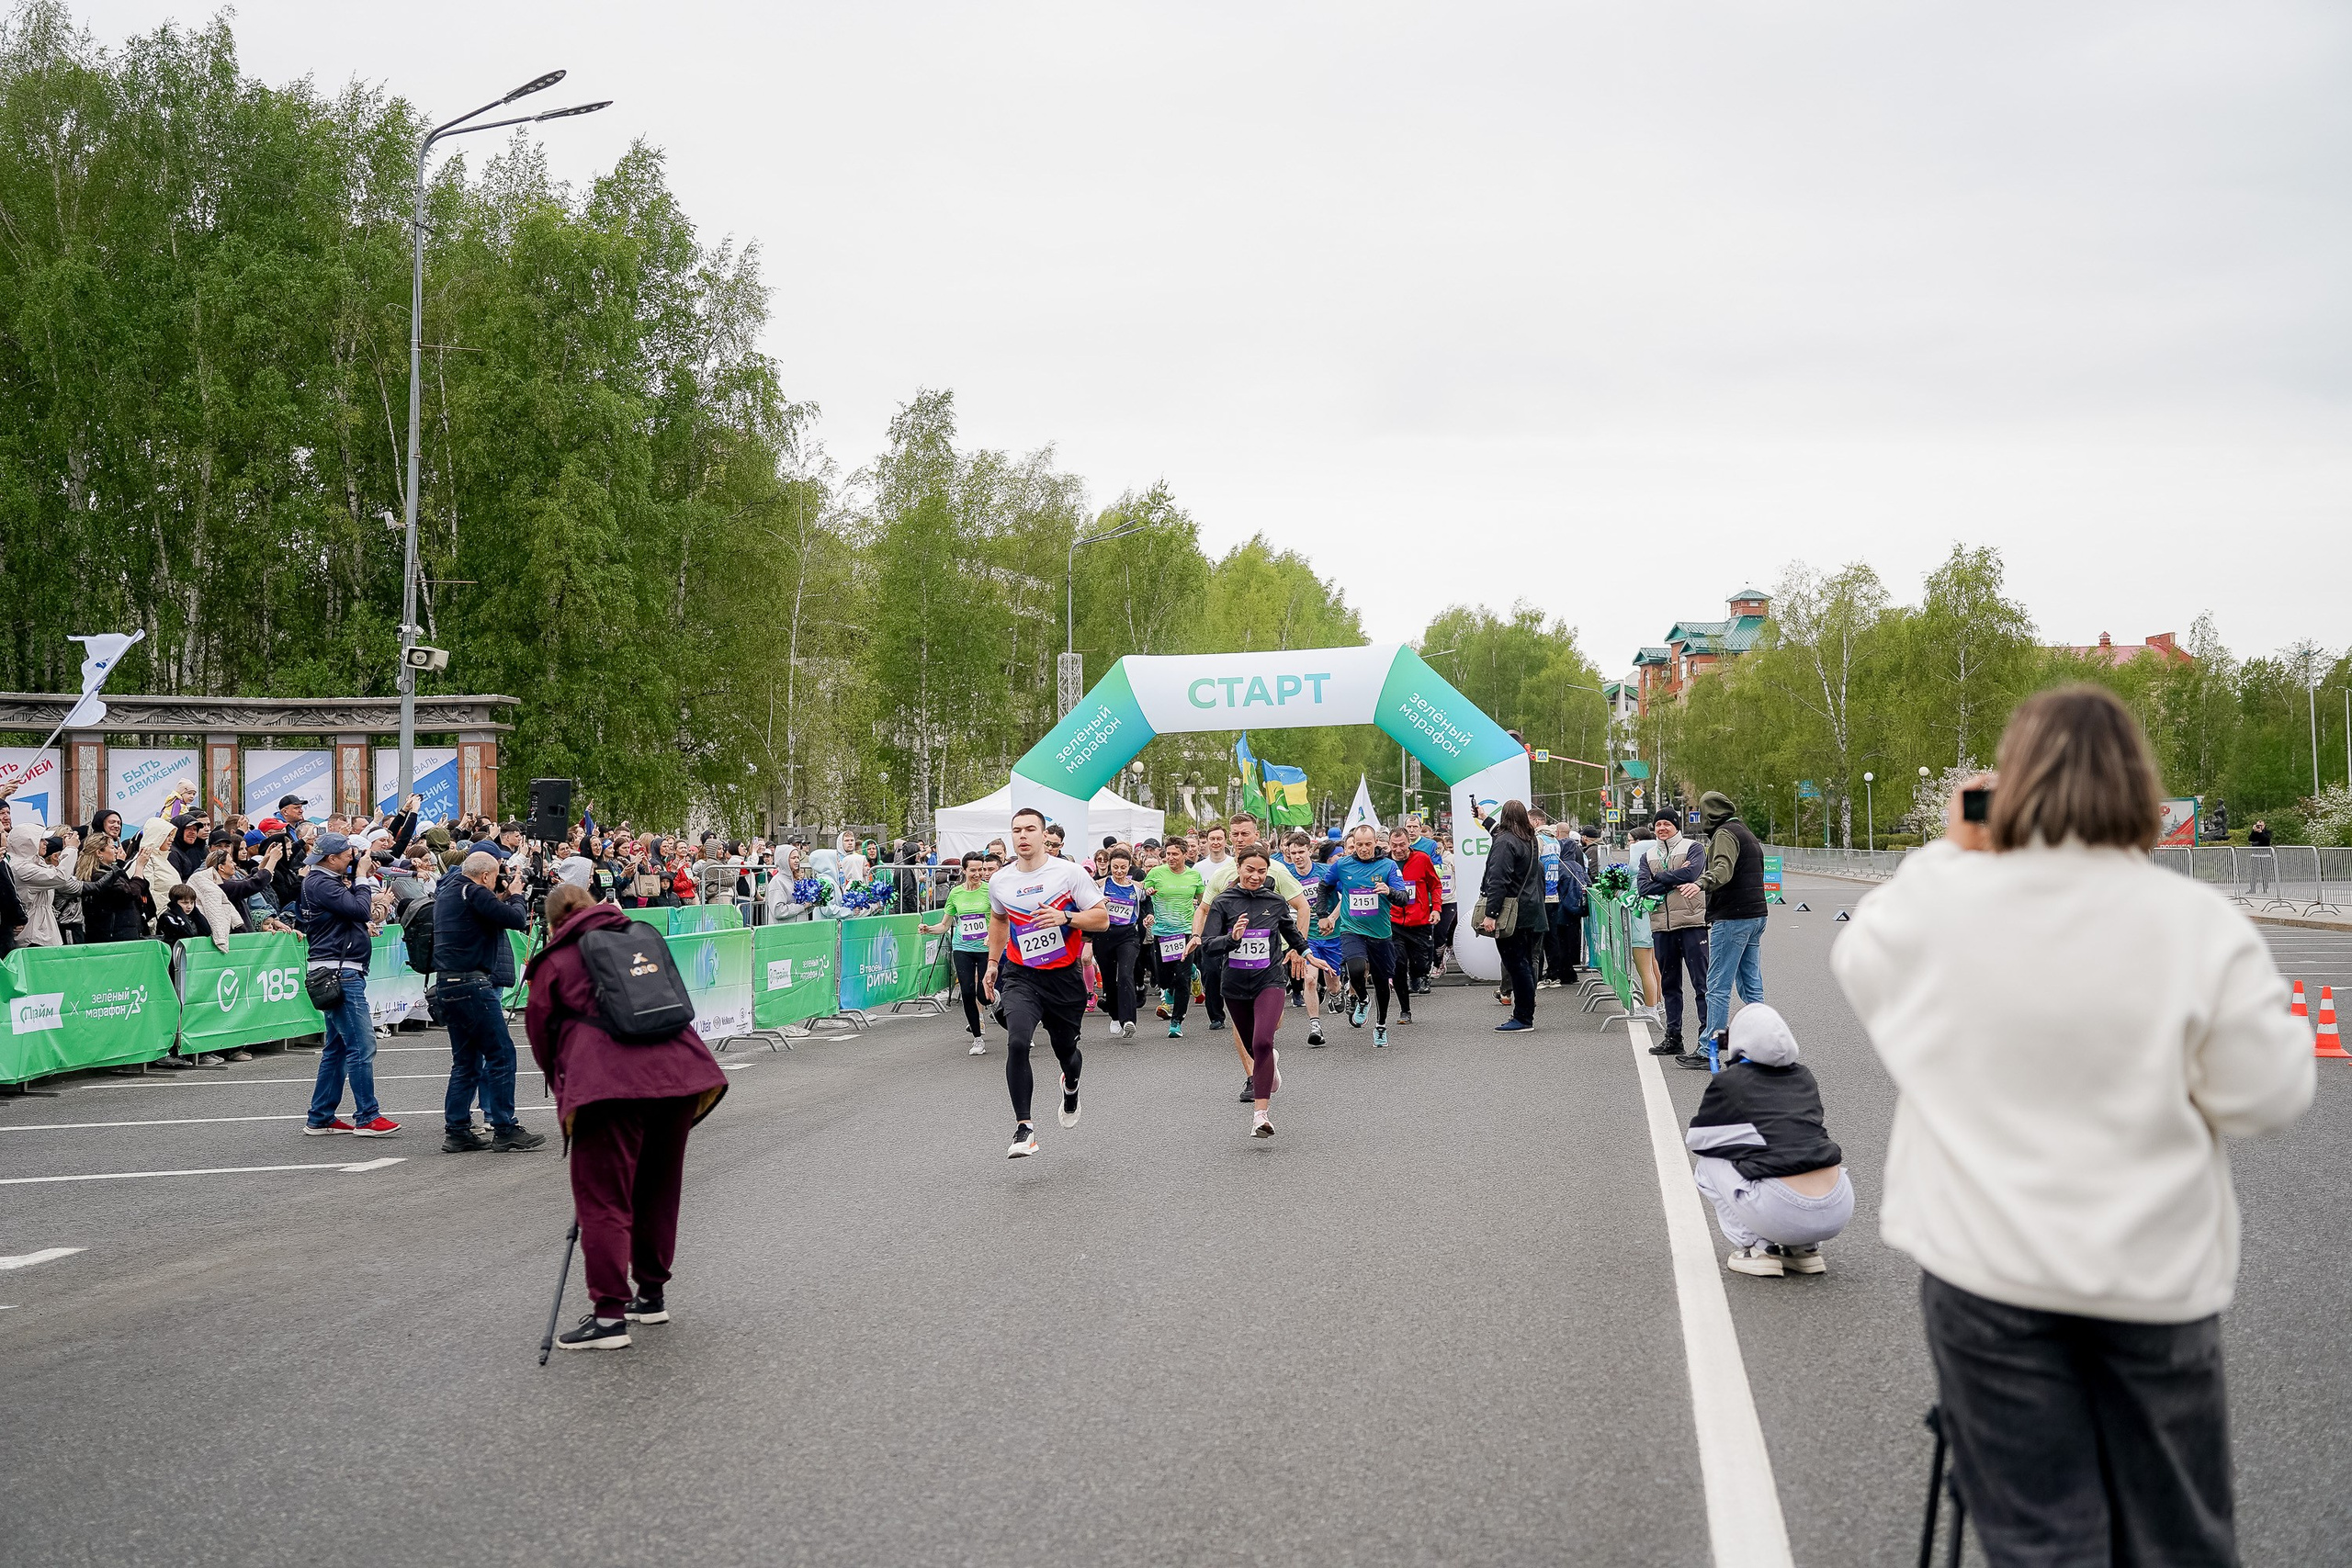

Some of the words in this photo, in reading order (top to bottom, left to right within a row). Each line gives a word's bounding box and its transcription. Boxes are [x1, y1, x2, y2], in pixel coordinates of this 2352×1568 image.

[1187, 672, 1330, 709] СТАРТ
[1398, 703, 1462, 758] марафон
[1408, 692, 1475, 747] зелёный
[1056, 704, 1113, 763] зелёный
[1065, 716, 1123, 774] марафон
[0, 762, 19, 779] ТЬ
[116, 790, 126, 801] В
[128, 755, 192, 796] ДВИЖЕНИИ
[121, 759, 162, 784] БЫТЬ
[251, 781, 282, 801] БЫТЬ
[281, 757, 324, 784] ВМЕСТЕ
[1109, 905, 1130, 916] 2074
[1352, 897, 1374, 907] 2151
[963, 921, 984, 931] 2100
[1023, 931, 1057, 953] 2289
[1164, 942, 1184, 953] 2185
[859, 964, 865, 975] В
[256, 966, 300, 1003] 185
[866, 970, 899, 992] ритме
[91, 987, 130, 1004] зелёный
[85, 1003, 127, 1021] марафон
